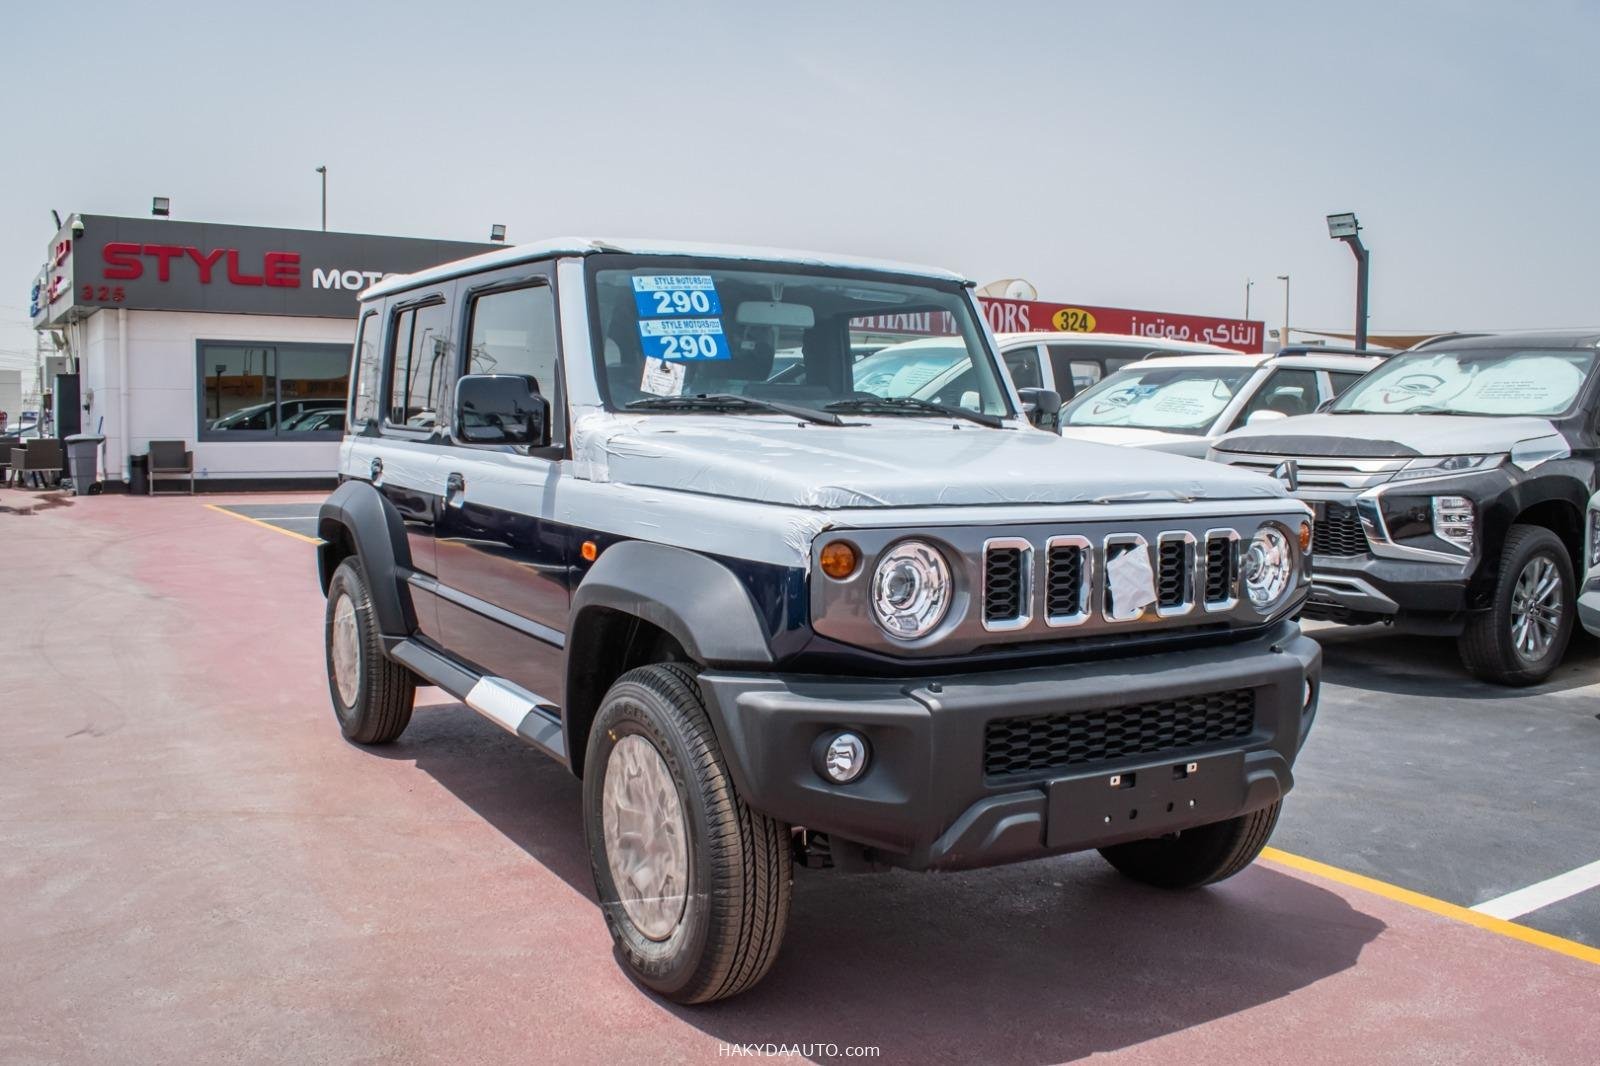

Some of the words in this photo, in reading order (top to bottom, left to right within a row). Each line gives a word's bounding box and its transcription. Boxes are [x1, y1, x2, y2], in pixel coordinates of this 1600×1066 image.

[102, 242, 301, 289] STYLE
[312, 267, 386, 291] MOT
[654, 276, 675, 285] STYLE
[677, 275, 702, 285] MOTORS
[653, 290, 710, 314] 290
[661, 321, 682, 329] STYLE
[684, 320, 709, 328] MOTORS
[1060, 310, 1089, 332] 324
[660, 334, 718, 359] 290
